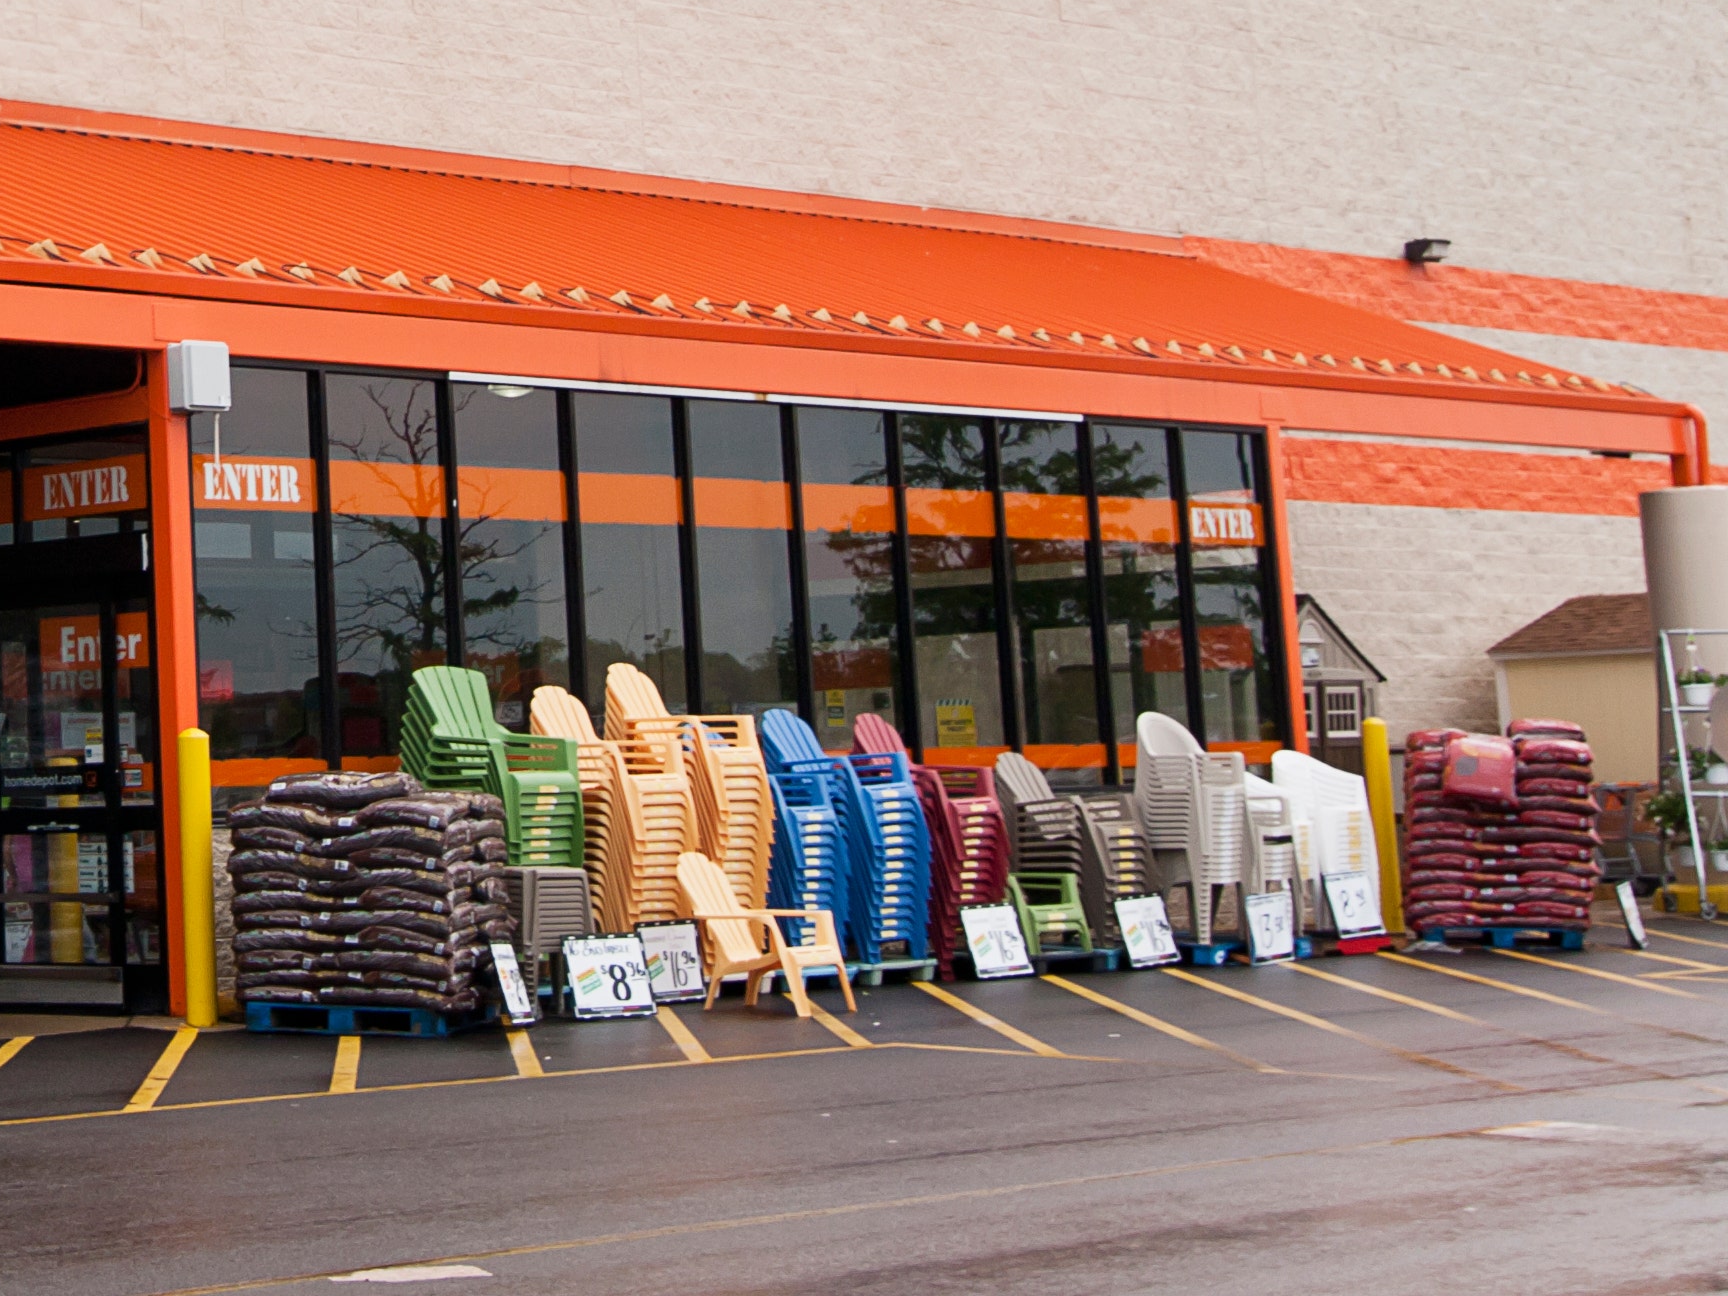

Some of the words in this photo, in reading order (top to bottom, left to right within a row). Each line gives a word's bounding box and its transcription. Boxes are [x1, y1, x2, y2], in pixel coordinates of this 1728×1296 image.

[42, 465, 129, 511] ENTER
[203, 462, 301, 503] ENTER
[1191, 507, 1255, 539] ENTER
[60, 626, 142, 663] Ener
[4, 773, 83, 789] homedepot.com
